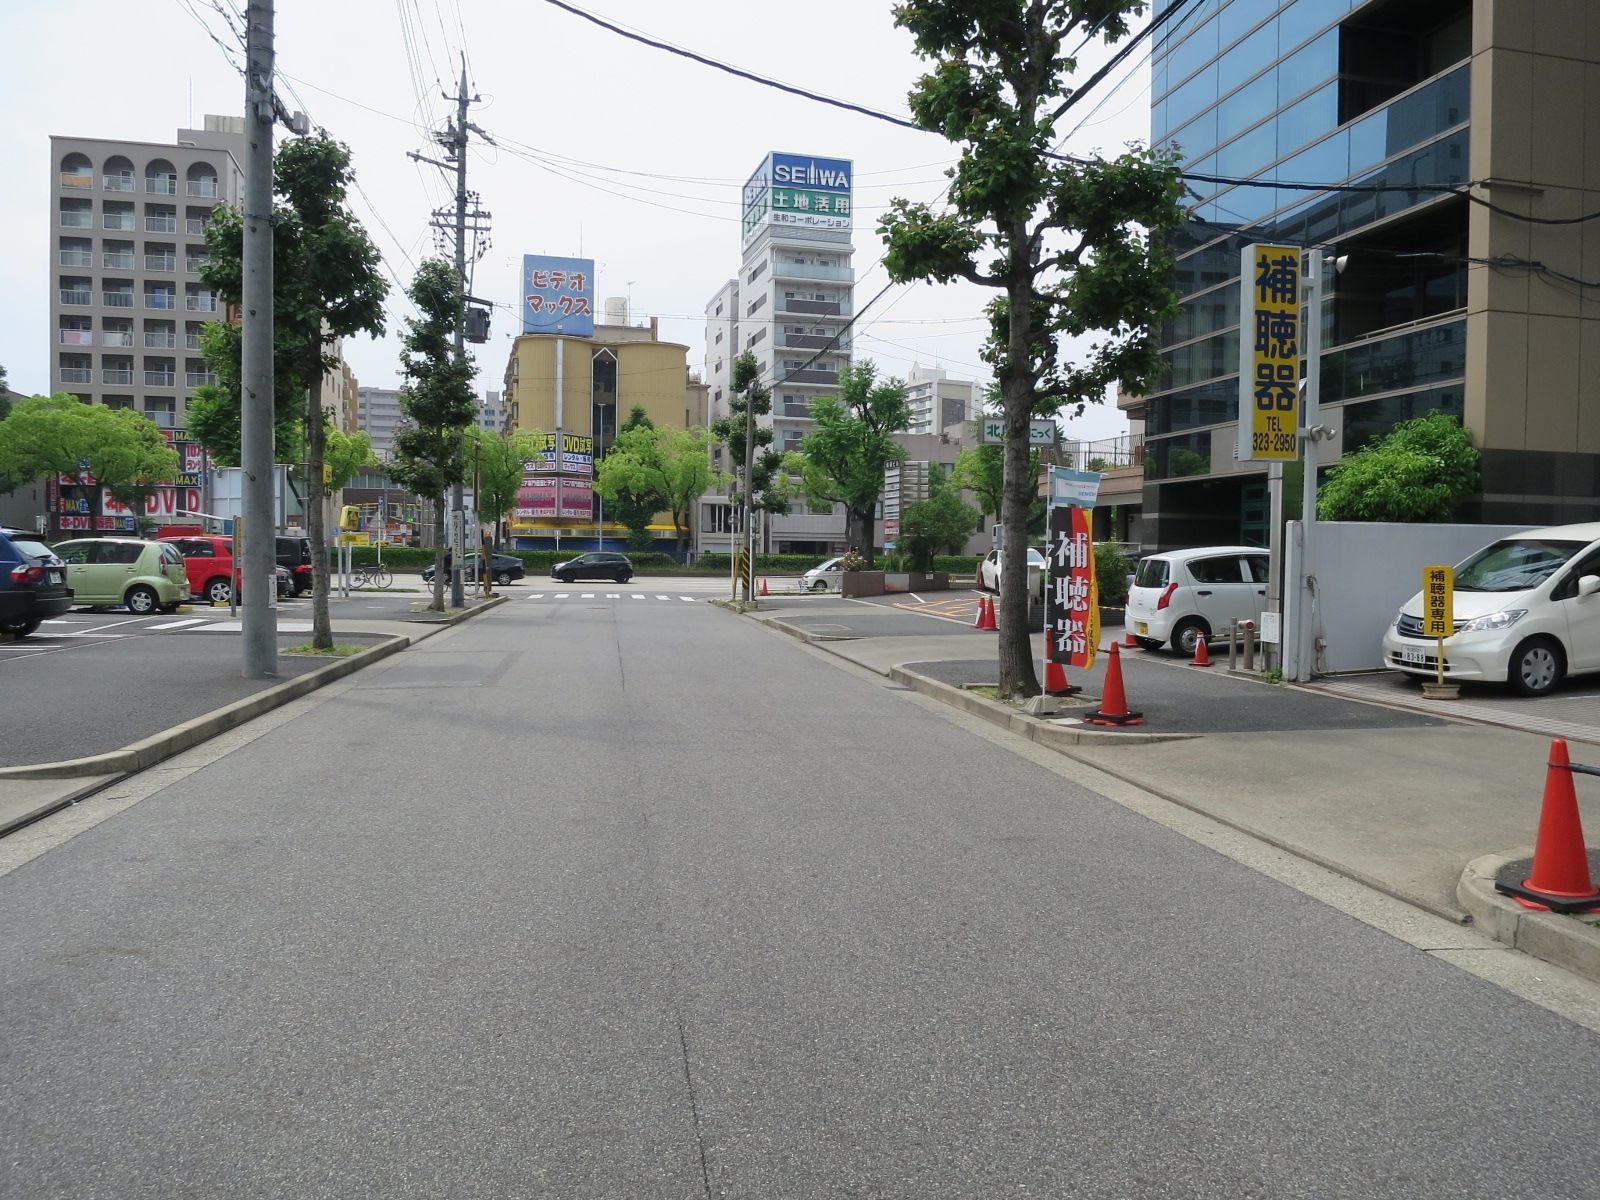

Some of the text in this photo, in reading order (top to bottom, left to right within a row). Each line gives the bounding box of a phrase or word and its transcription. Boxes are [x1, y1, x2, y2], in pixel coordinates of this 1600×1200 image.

[773, 191, 849, 214] 土地活用
[773, 213, 850, 228] 生和コーポレーション
[533, 270, 586, 292] ビデオ
[525, 295, 592, 316] マックス
[1255, 254, 1298, 412] 補聴器
[1266, 417, 1282, 432] TEL
[1252, 434, 1296, 451] 323-2950
[175, 475, 197, 485] MAX
[146, 489, 200, 514] DVD
[1054, 531, 1089, 655] 補聴器
[1430, 569, 1446, 633] 補聴器専用
